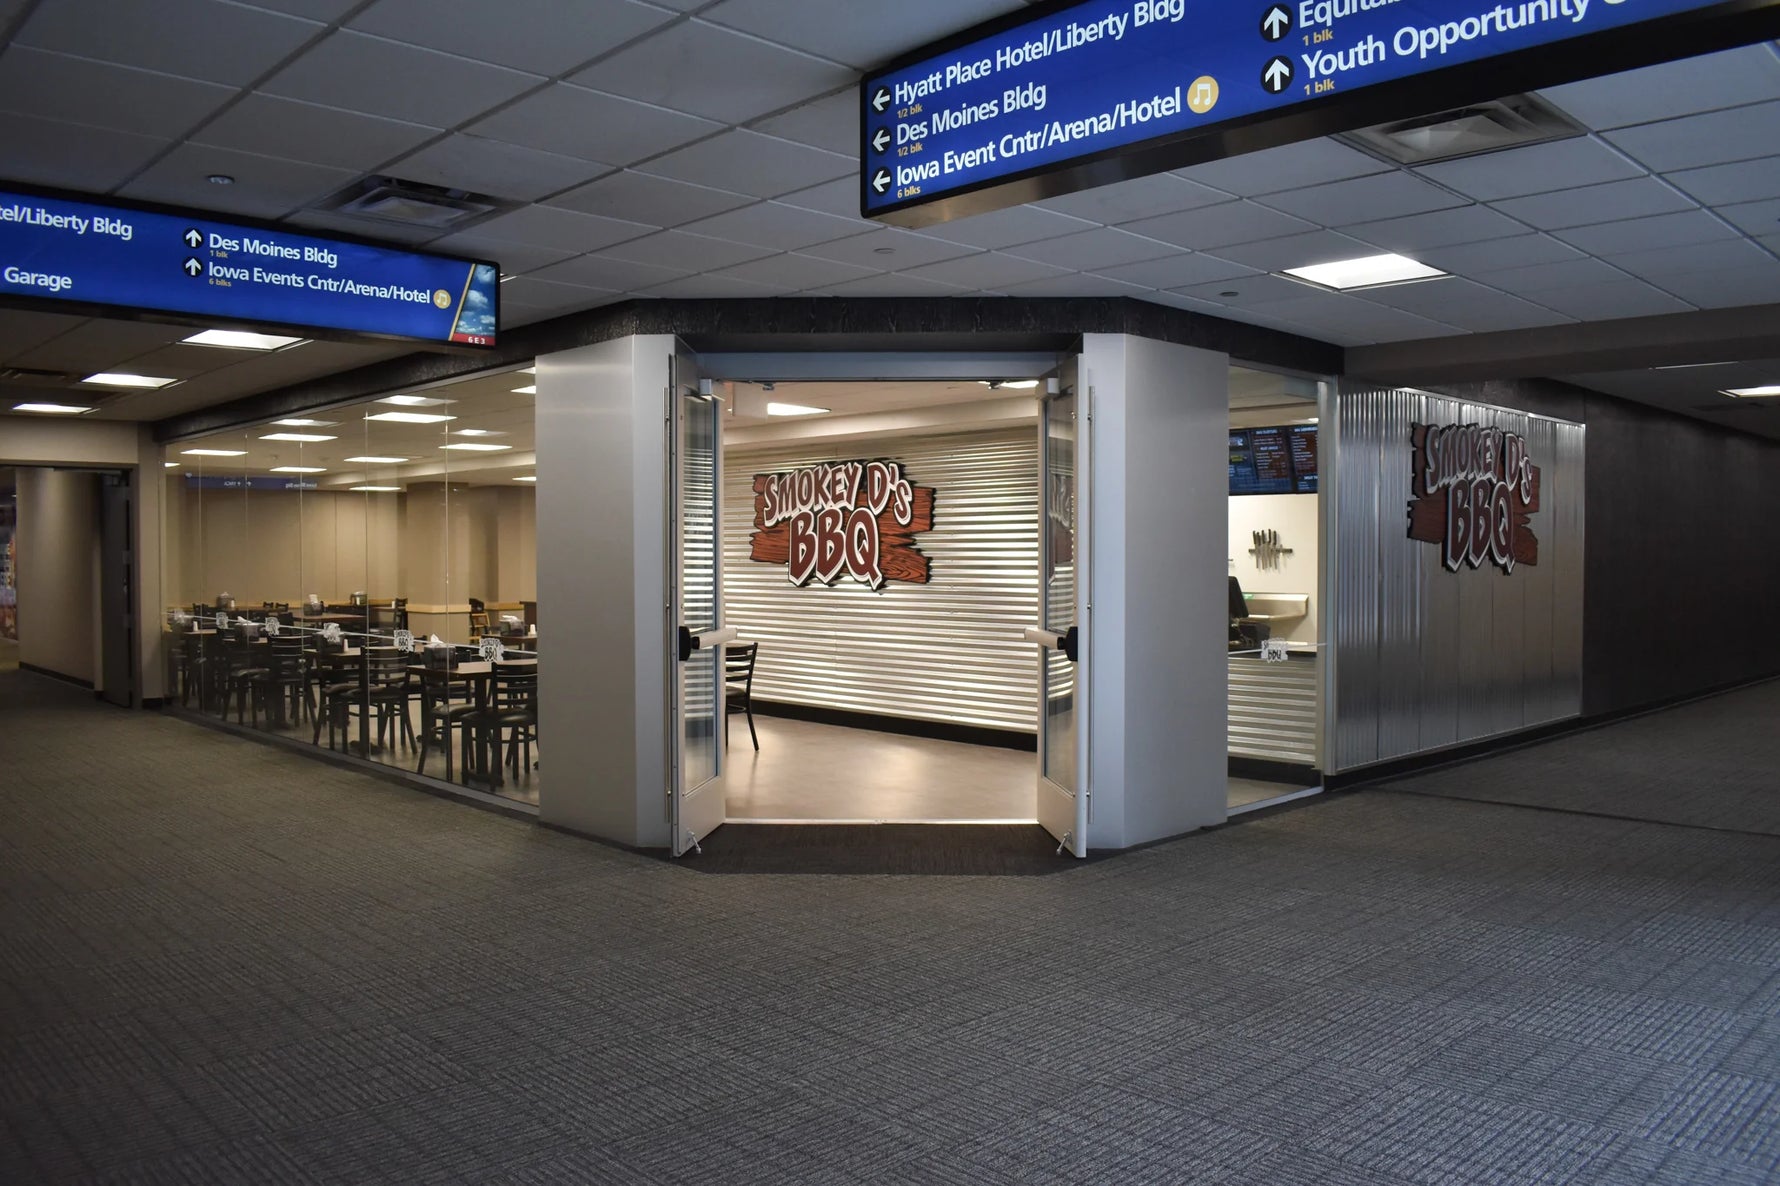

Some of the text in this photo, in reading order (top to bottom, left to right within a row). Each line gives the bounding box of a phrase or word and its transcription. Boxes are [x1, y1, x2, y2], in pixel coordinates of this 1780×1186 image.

[1299, 0, 1400, 29] Equit
[895, 0, 1185, 105] Hyatt Place Hotel/Liberty Bldg
[1301, 0, 1588, 79] Youth Opportunity
[1303, 29, 1334, 46] 1 blk
[1304, 78, 1335, 95] 1 blk
[897, 104, 923, 119] 1/2 blk
[897, 82, 1047, 145] Des Moines Bldg
[897, 86, 1181, 186] Iowa Event Cntr/Arena/Hotel
[897, 143, 923, 157] 1/2 blk
[897, 185, 921, 198] 6 blks
[93, 217, 133, 241] Bldg
[209, 233, 338, 269] Des Moines Bldg
[4, 266, 72, 292] Garage
[209, 262, 431, 304] Iowa Events Cntr/Arena/Hotel
[1425, 425, 1503, 494] SMOKEY
[763, 462, 862, 527] SMOKEY
[1447, 477, 1515, 573] BBQ
[788, 507, 882, 590] BBQ
